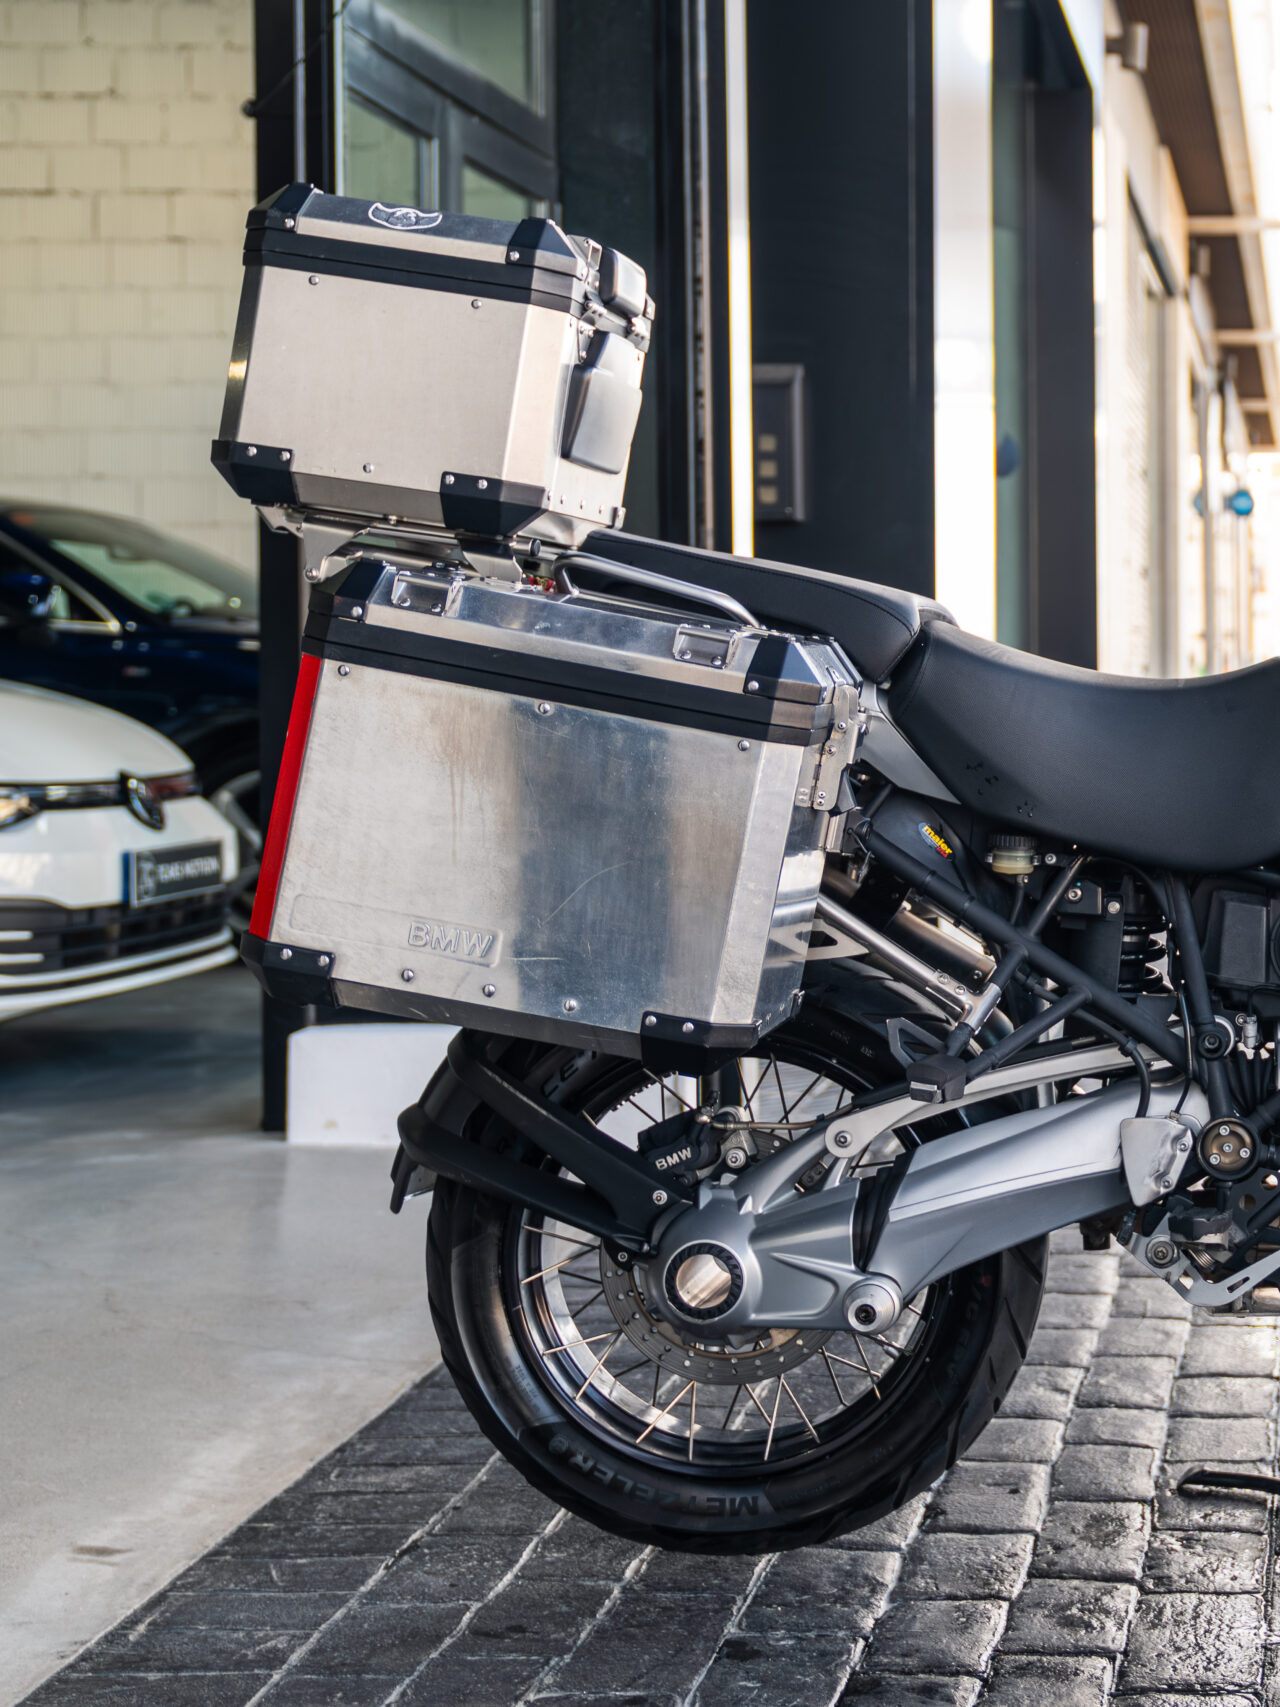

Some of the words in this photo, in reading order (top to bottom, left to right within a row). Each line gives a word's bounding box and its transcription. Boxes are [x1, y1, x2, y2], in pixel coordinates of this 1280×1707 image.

[408, 921, 495, 958] BMW
[655, 1147, 692, 1170] BMW
[569, 1450, 760, 1517] METZELER
